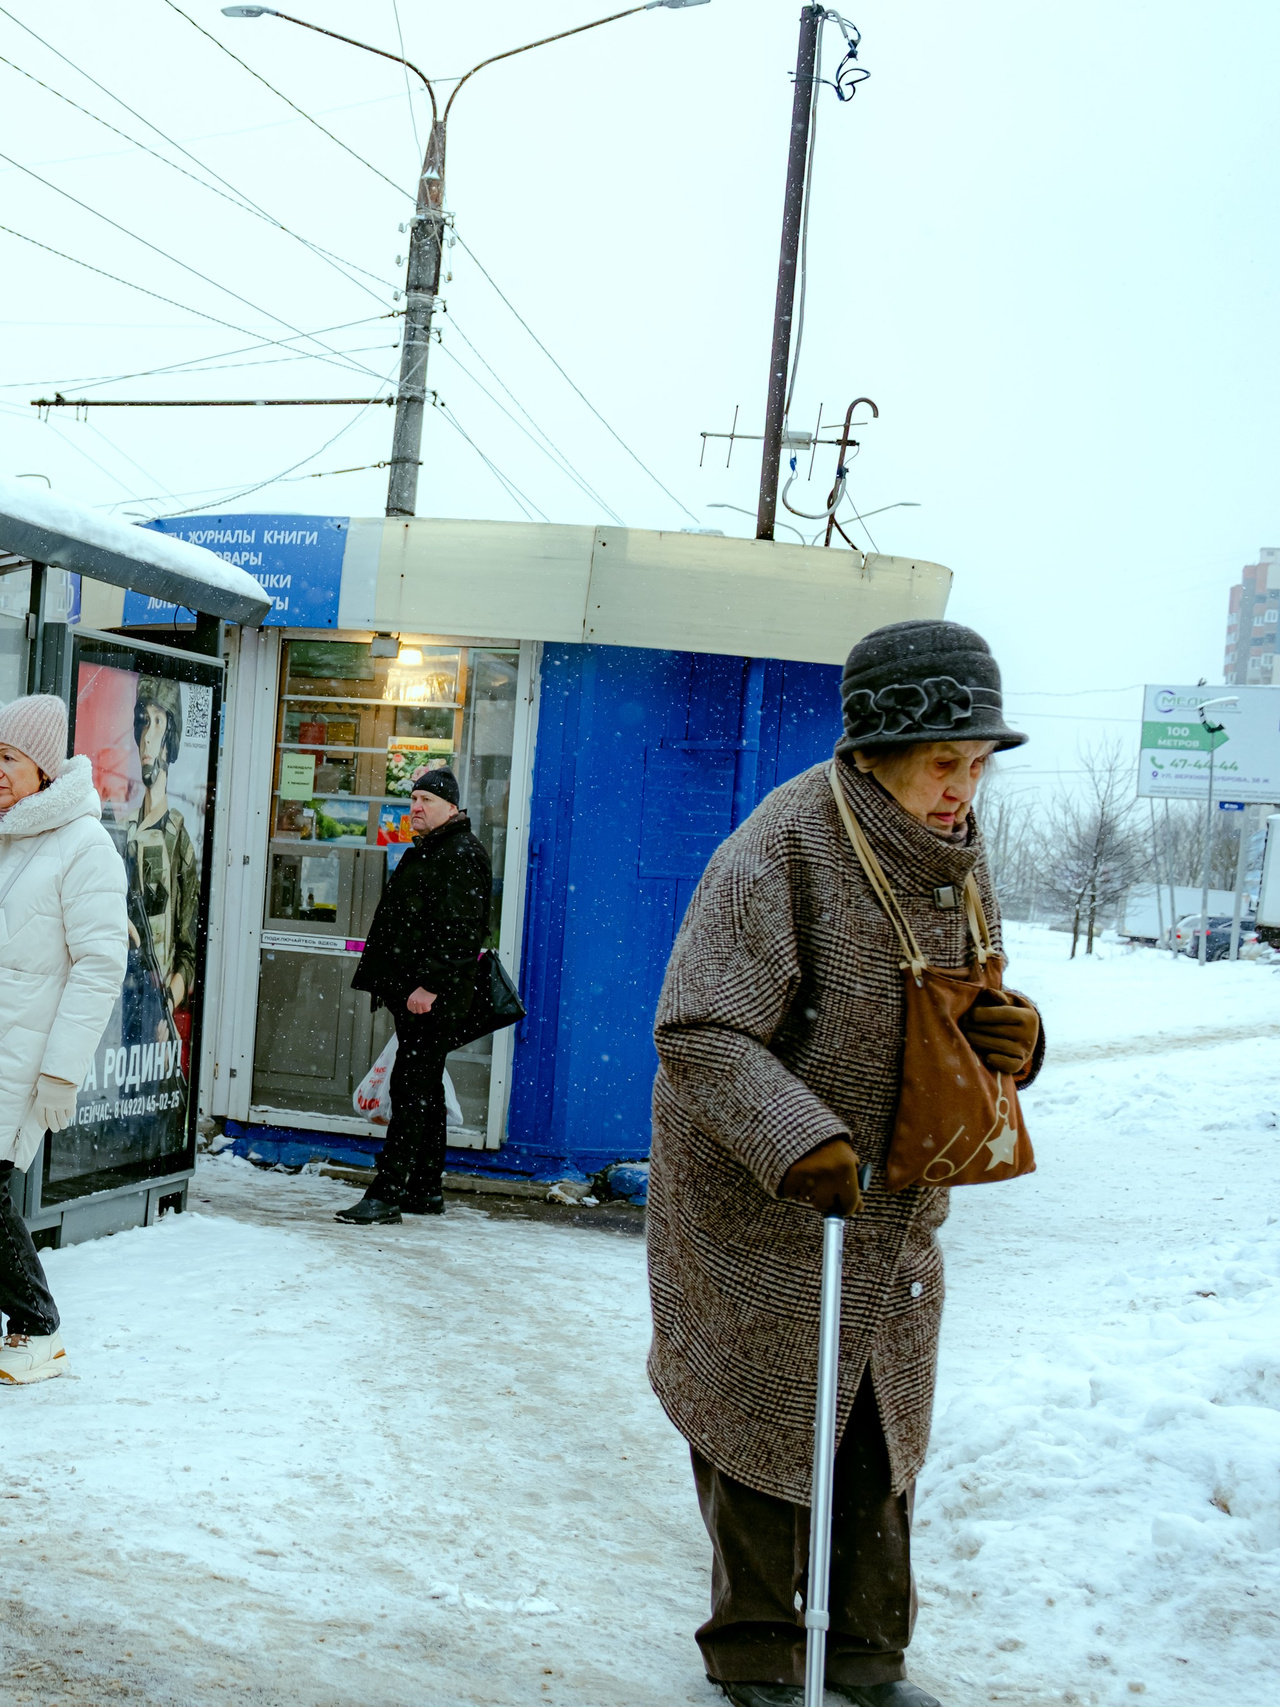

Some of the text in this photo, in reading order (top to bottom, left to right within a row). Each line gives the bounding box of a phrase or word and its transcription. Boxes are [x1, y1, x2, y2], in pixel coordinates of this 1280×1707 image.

[188, 529, 255, 545] ЖУРНАЛЫ
[263, 530, 318, 545] КНИГИ
[1166, 726, 1190, 737] 100
[1157, 739, 1200, 748] МЕТРОВ
[1169, 758, 1239, 772] 47-44-44
[264, 935, 317, 945] ПОДКЛЮЧАЙТЕСЬ
[103, 1039, 183, 1093] РОДИНУ!
[78, 1101, 112, 1125] СЕЙЧАС:
[114, 1101, 120, 1118] 8
[120, 1096, 145, 1119] (4922)
[146, 1090, 180, 1112] 45-02-25
